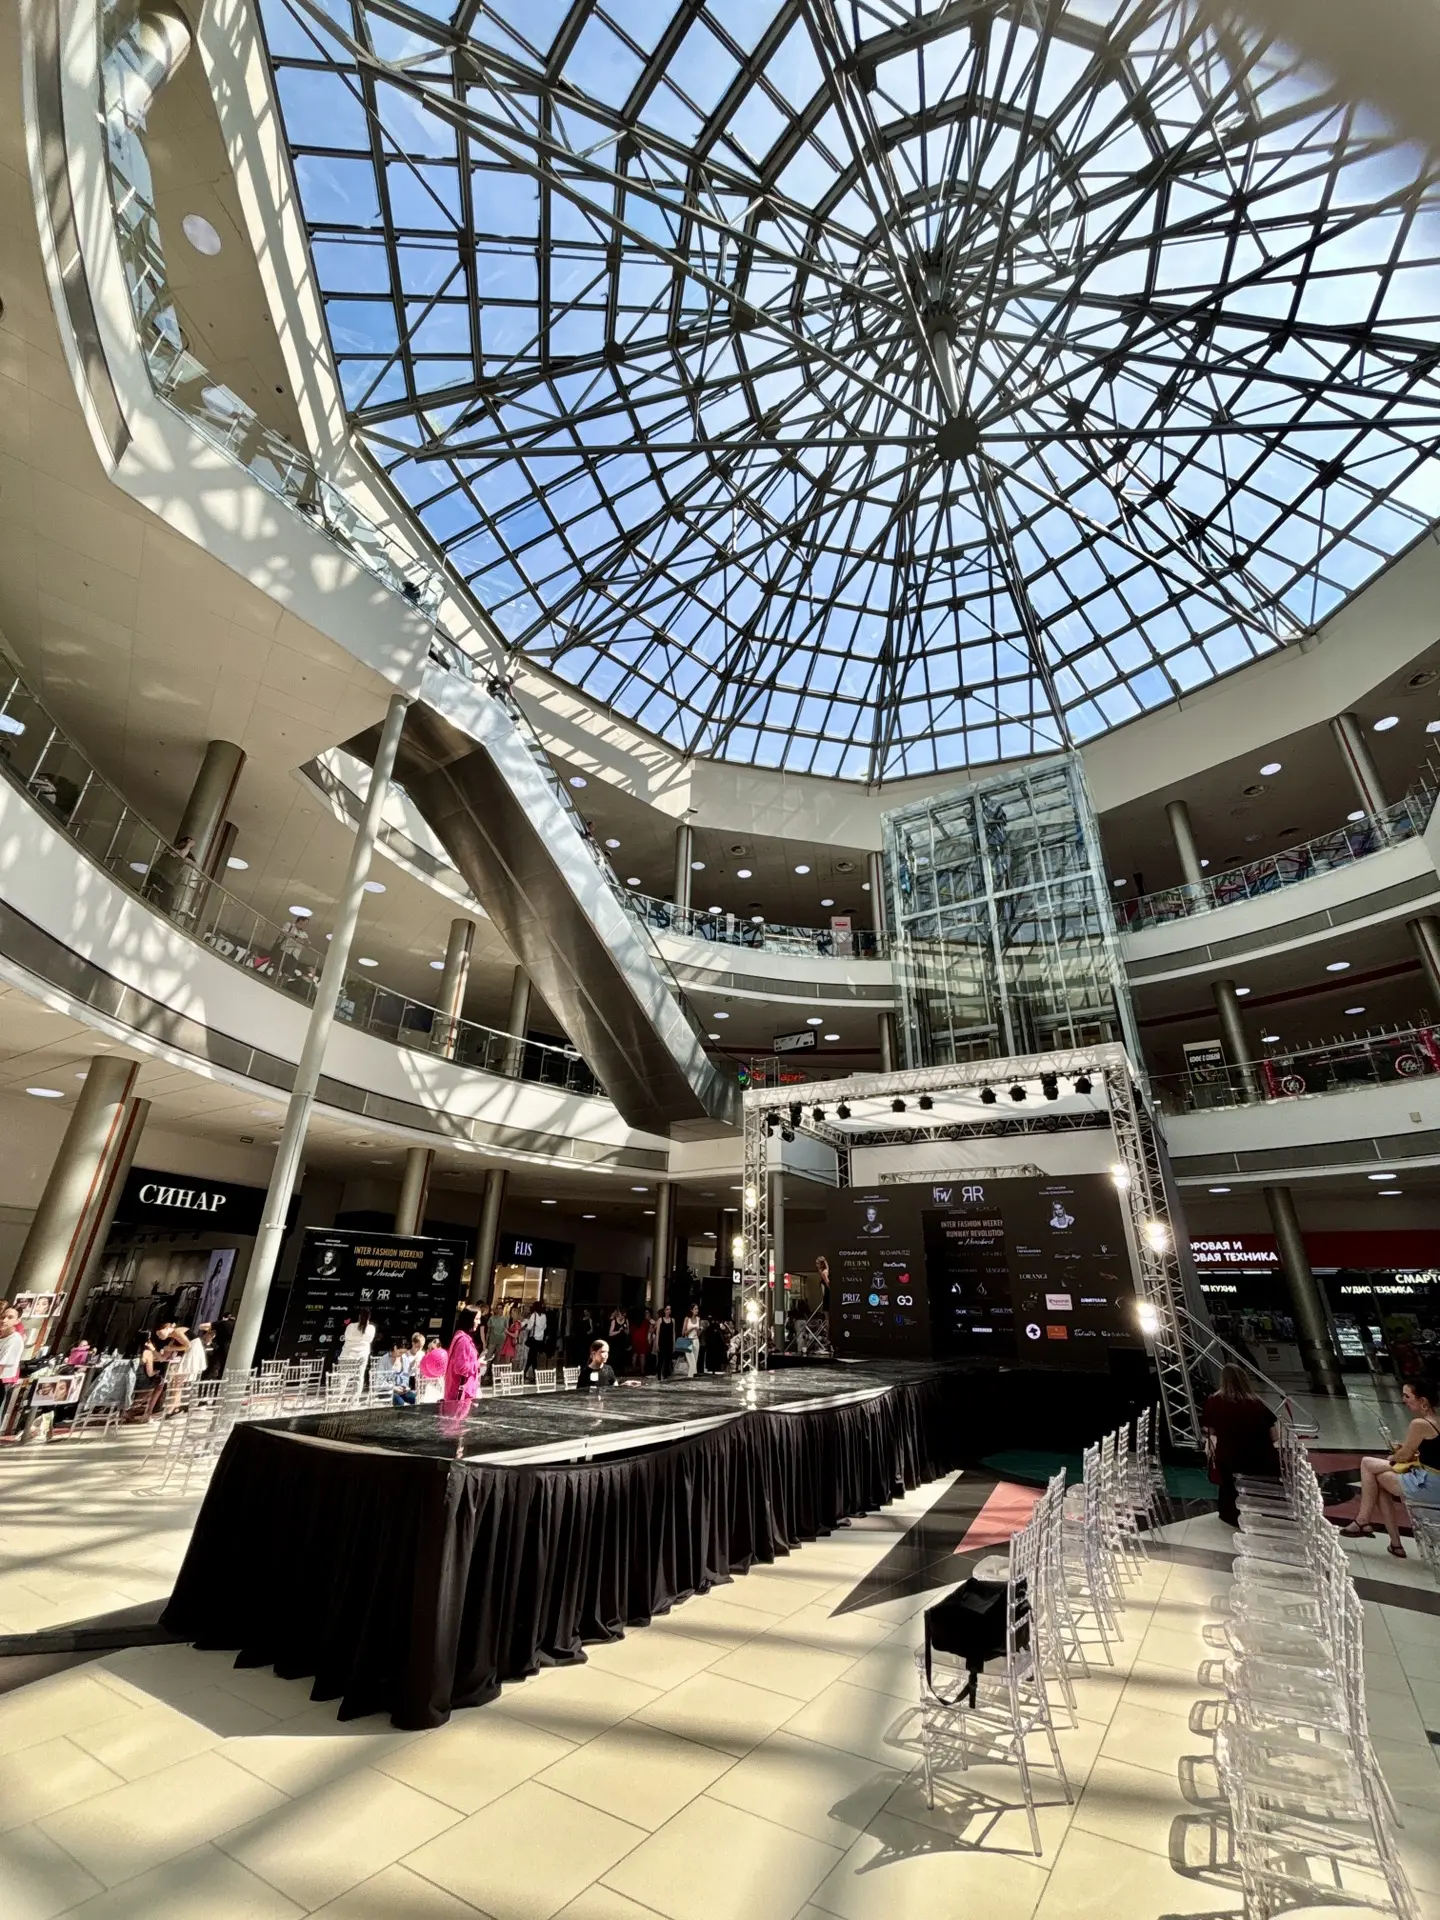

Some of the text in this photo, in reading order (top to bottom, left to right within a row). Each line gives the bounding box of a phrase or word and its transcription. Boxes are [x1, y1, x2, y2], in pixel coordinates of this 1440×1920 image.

[139, 1183, 227, 1212] СИНАР
[957, 1220, 981, 1228] FASHION
[946, 1230, 970, 1238] RUNWAY
[514, 1240, 533, 1256] ELIS
[1232, 1241, 1243, 1250] И
[354, 1246, 372, 1255] INTER
[372, 1247, 398, 1257] FASHION
[398, 1249, 424, 1259] WEEKEND
[1223, 1251, 1279, 1262] ТЕХНИКА
[356, 1258, 418, 1270] RUNWAY REVOLUTION
[1210, 1285, 1238, 1293] КУХНИ
[842, 1293, 861, 1302] PRIZ
